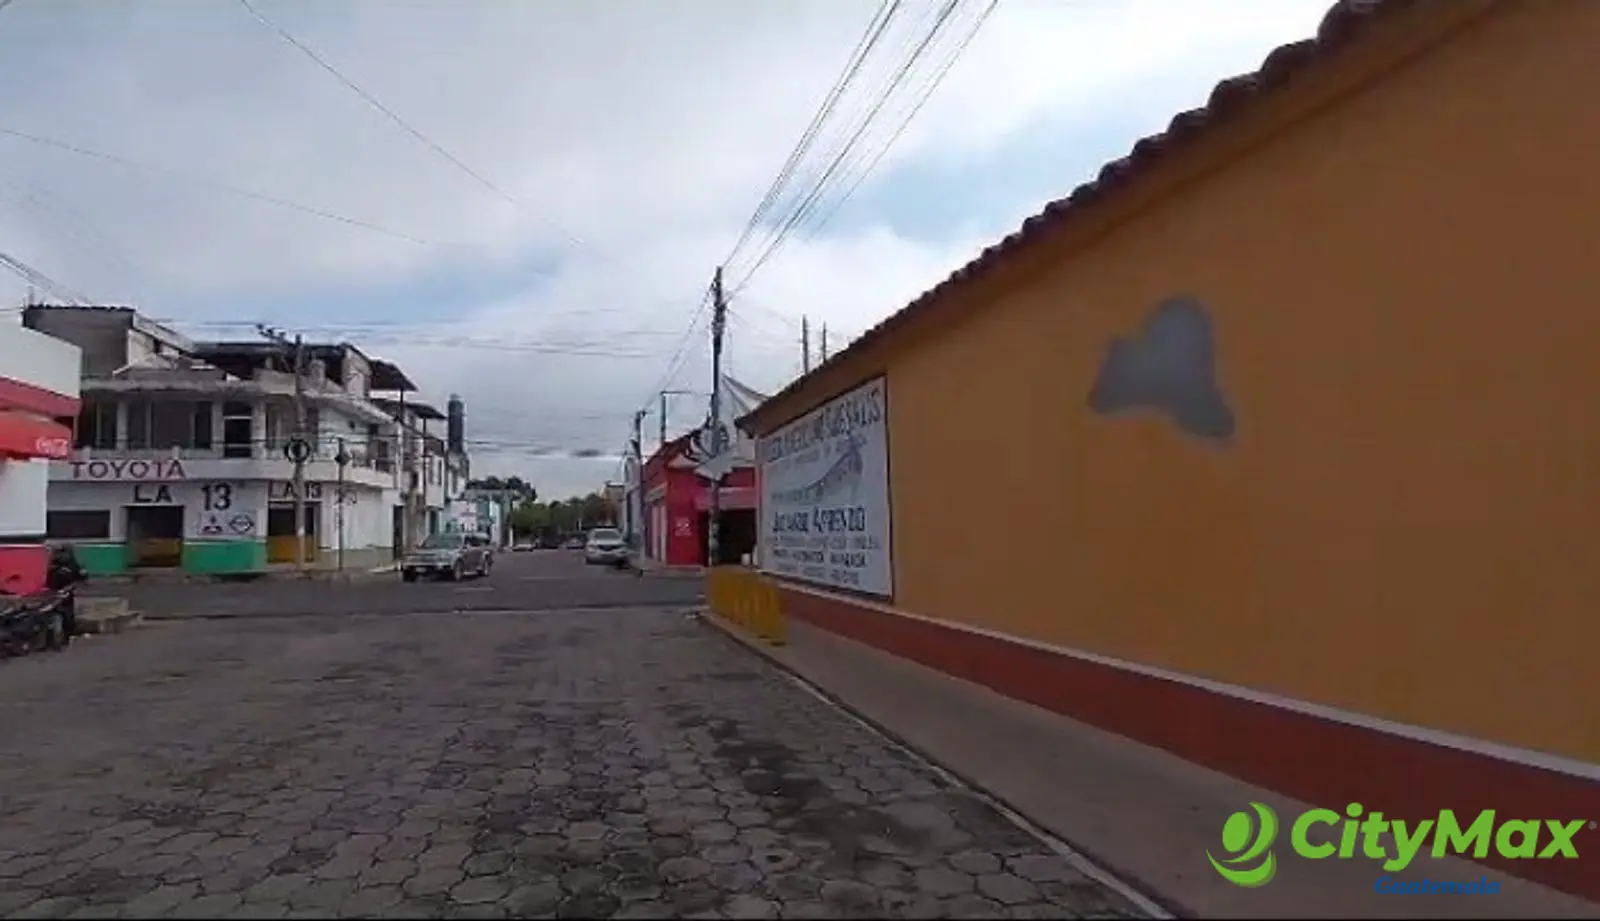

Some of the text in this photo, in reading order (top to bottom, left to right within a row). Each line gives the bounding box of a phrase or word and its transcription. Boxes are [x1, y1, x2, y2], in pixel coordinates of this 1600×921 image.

[70, 461, 186, 479] TOYOTA
[134, 482, 232, 511] LA 13
